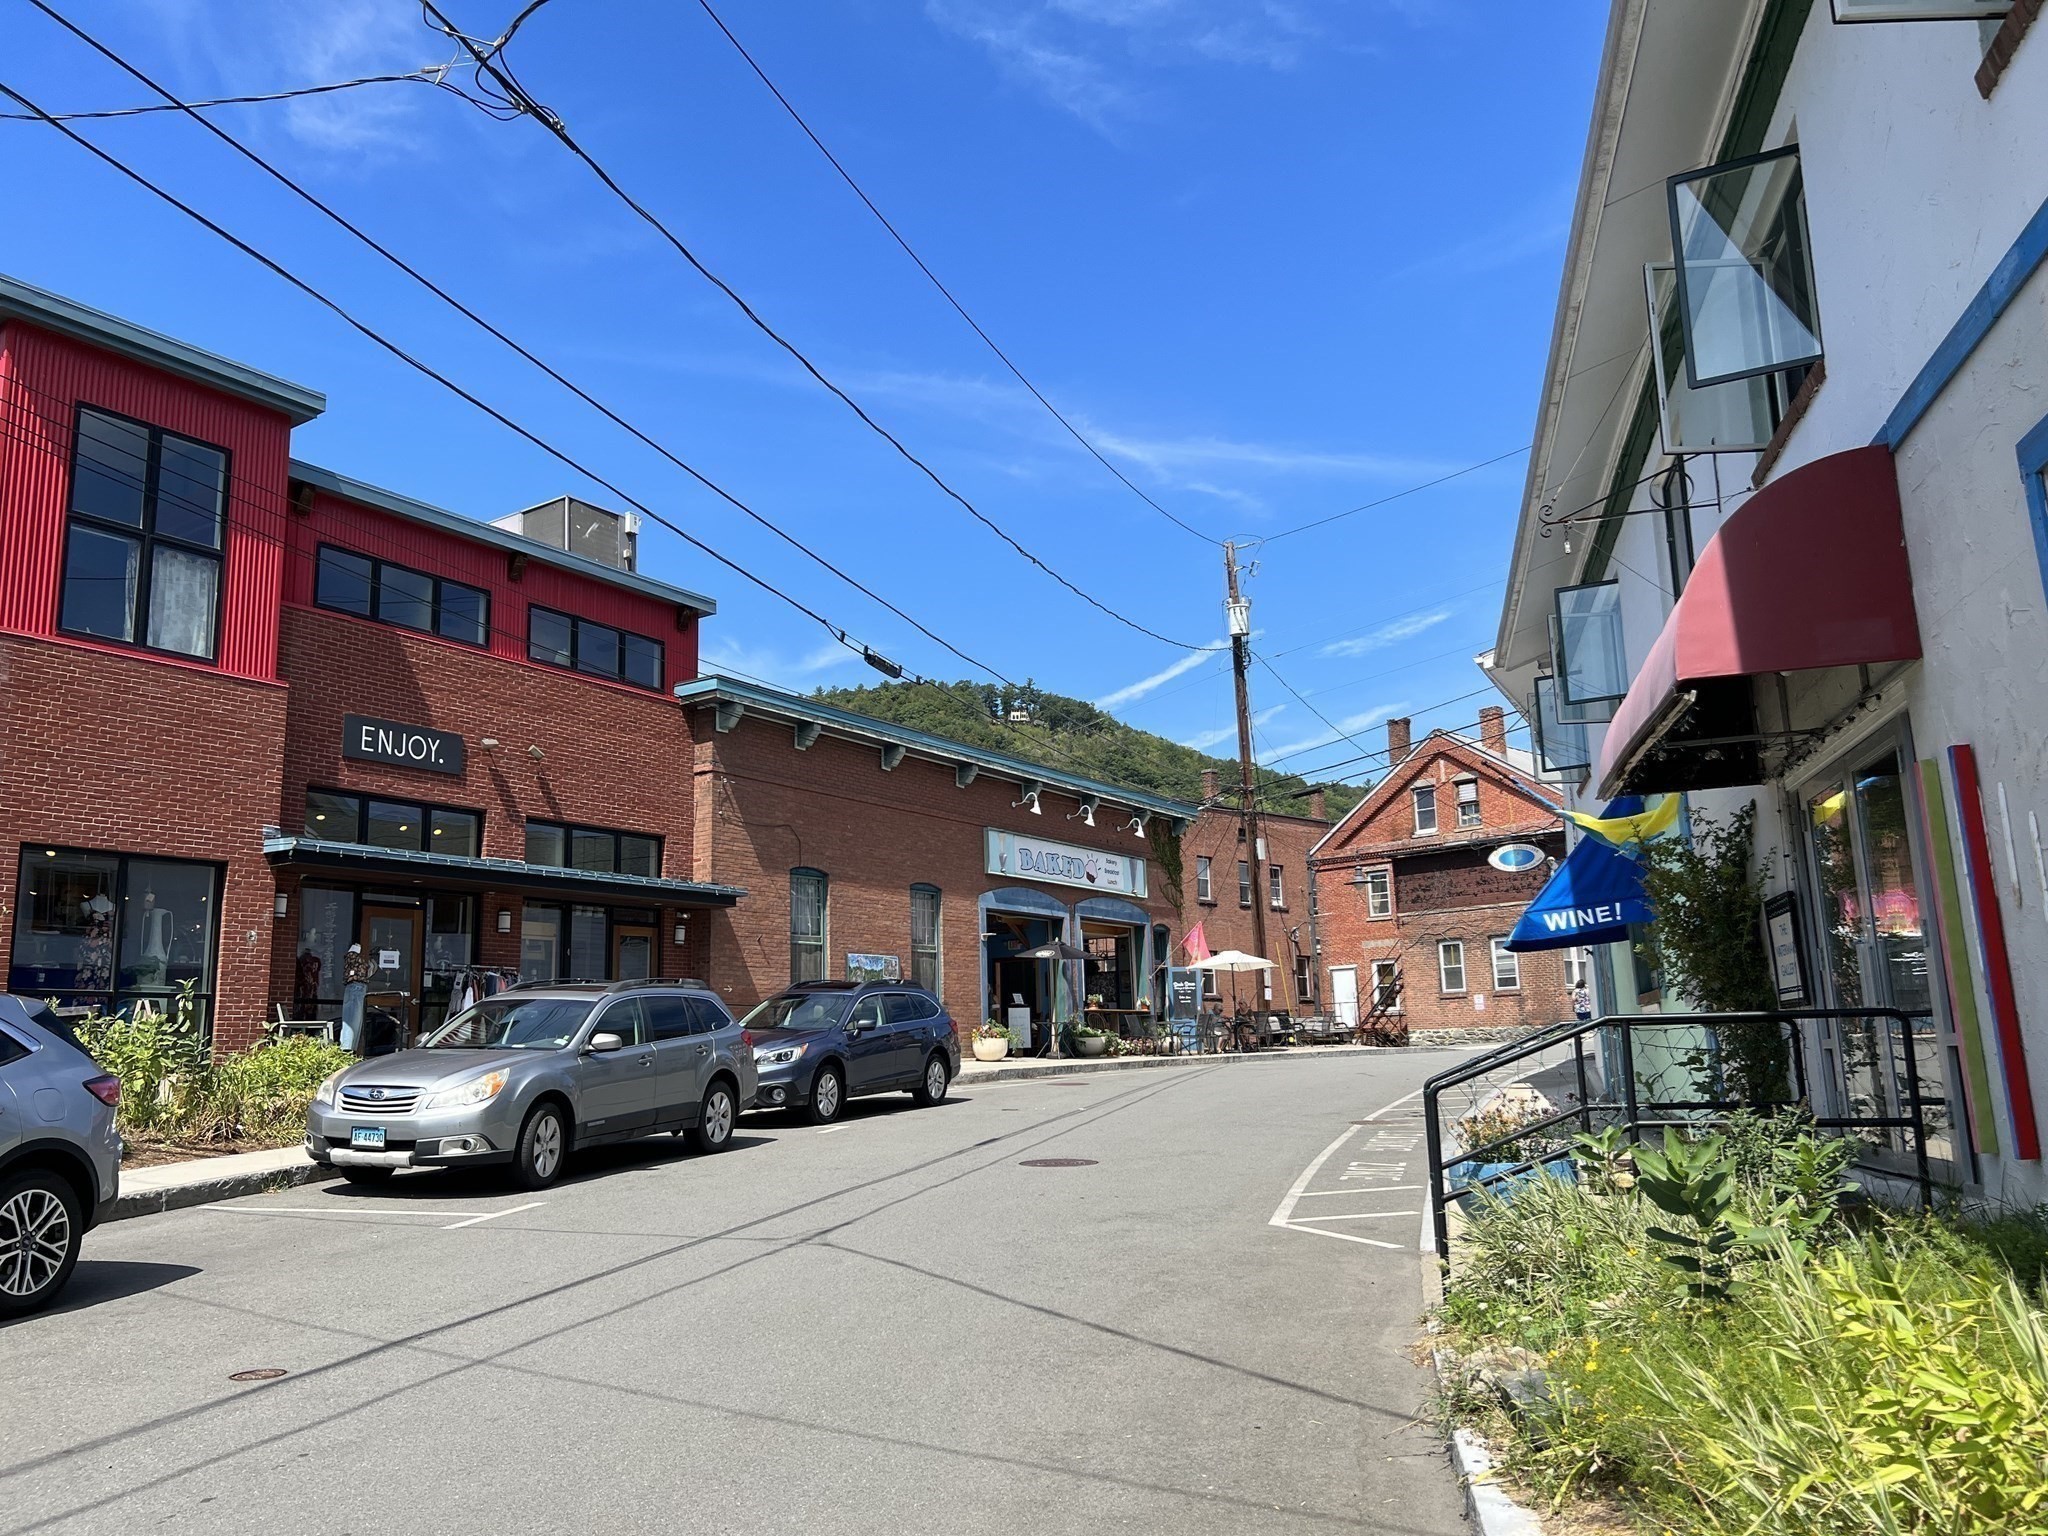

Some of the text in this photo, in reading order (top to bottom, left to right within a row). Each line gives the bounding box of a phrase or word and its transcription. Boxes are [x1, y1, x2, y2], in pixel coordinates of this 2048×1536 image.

[361, 725, 444, 764] ENJOY.
[1018, 848, 1085, 879] BAKED
[1543, 902, 1622, 932] WINE!
